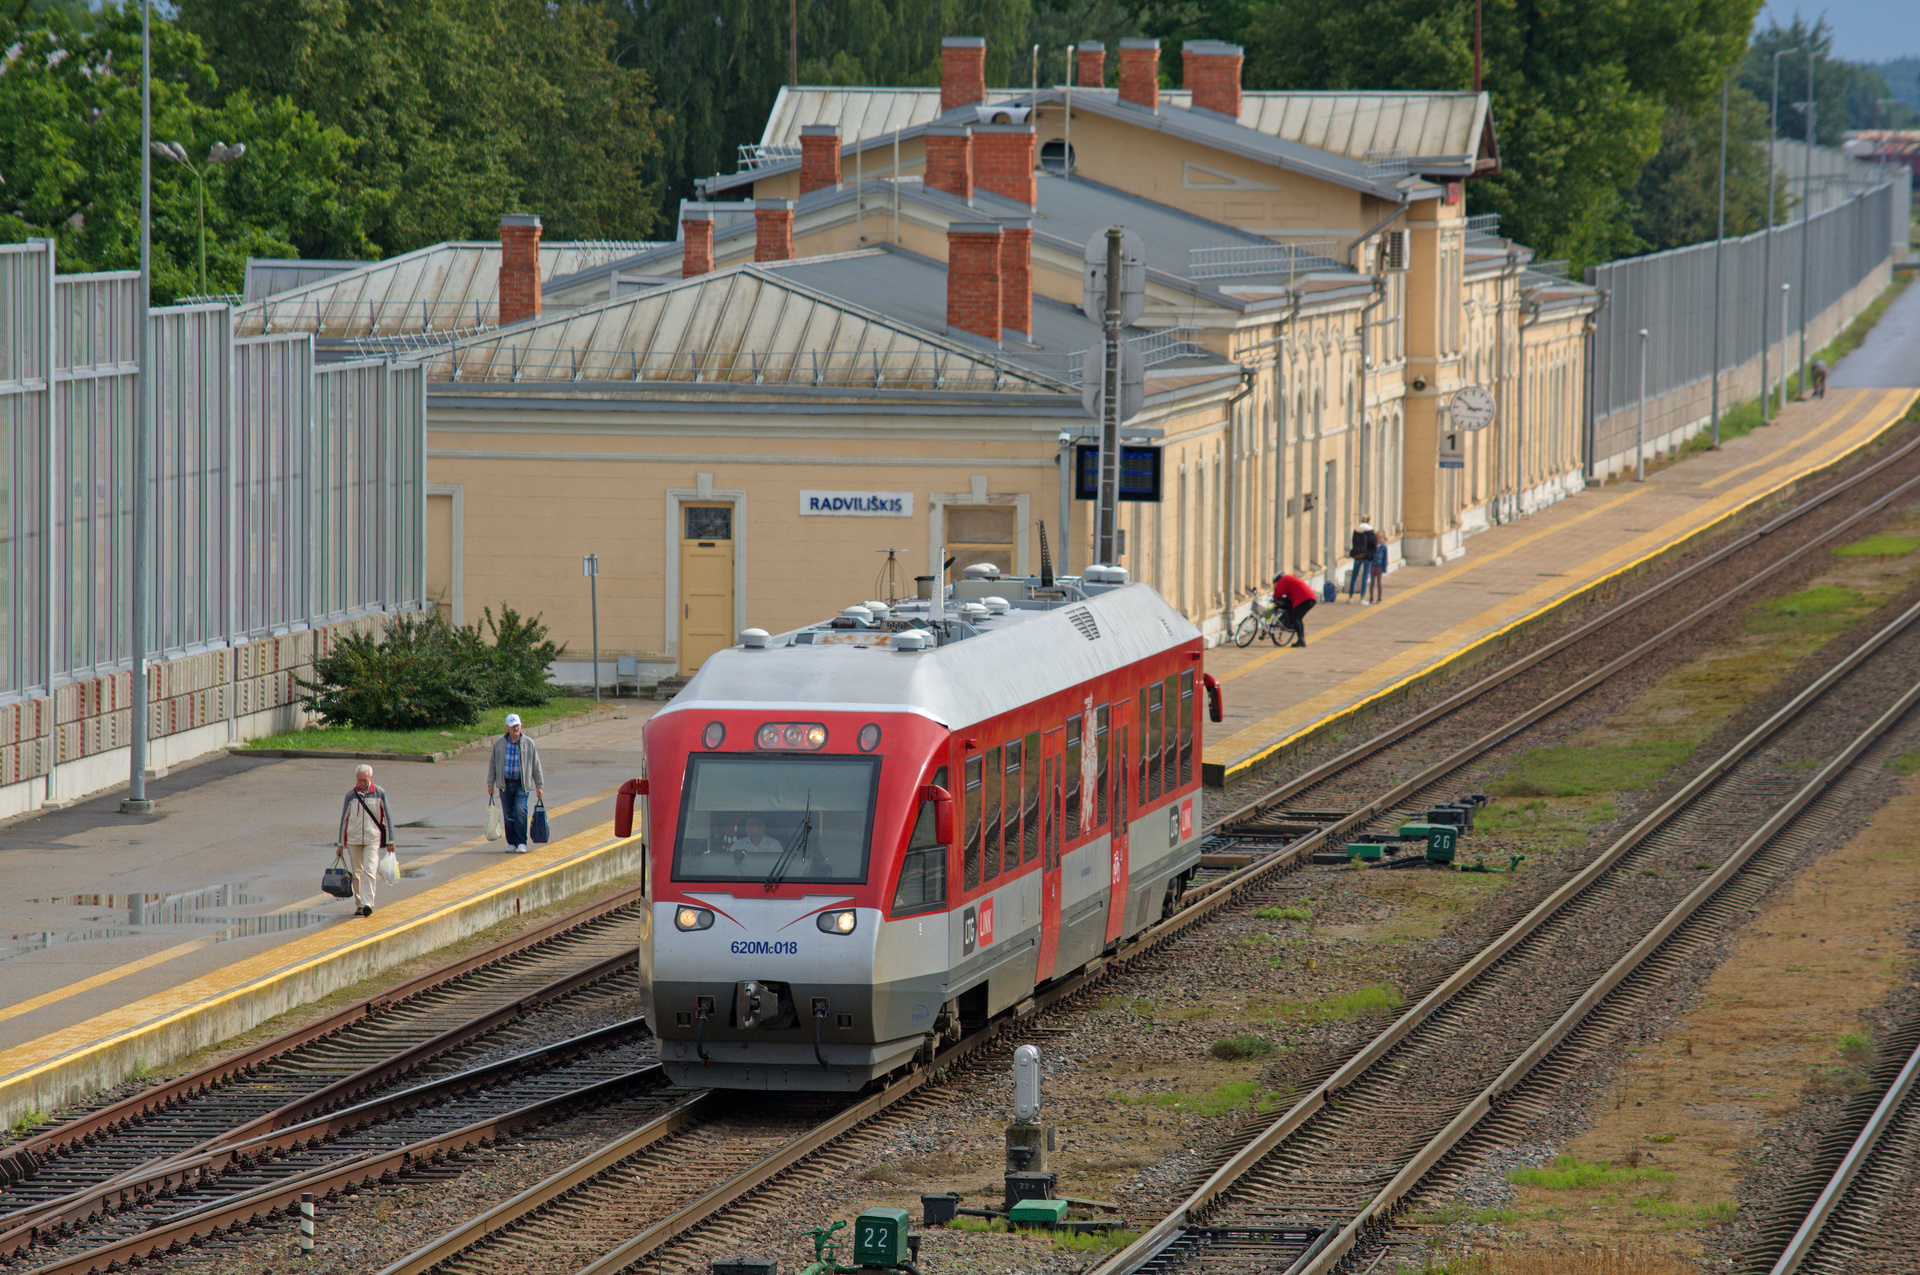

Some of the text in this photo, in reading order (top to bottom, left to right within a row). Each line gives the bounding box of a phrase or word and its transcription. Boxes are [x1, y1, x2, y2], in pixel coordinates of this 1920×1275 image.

[1446, 433, 1456, 450] 1
[810, 495, 902, 512] RADVILIŠKIS
[1433, 834, 1450, 849] 26
[965, 908, 992, 945] LTG LINK
[864, 1227, 888, 1248] 22
